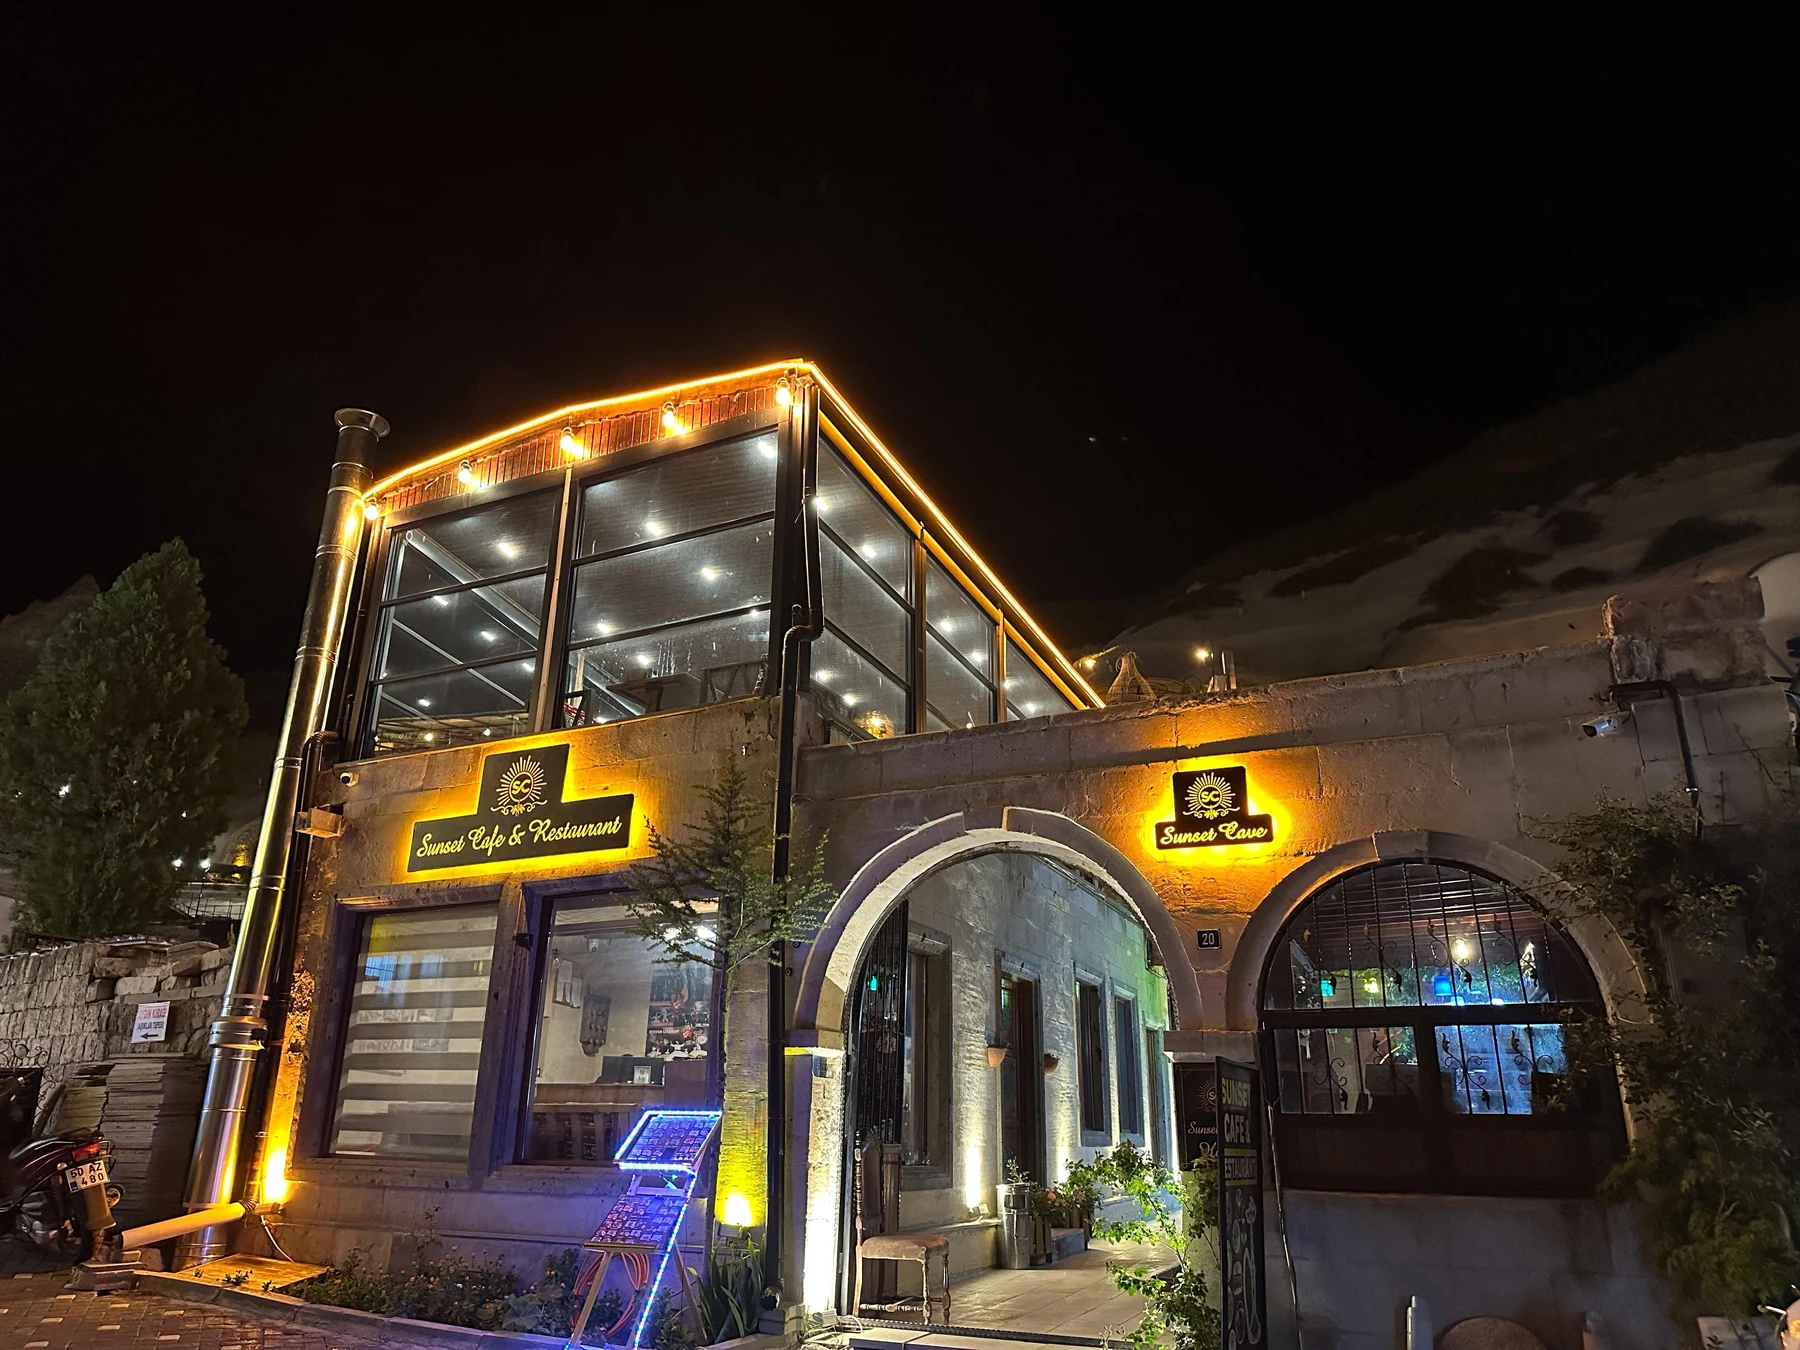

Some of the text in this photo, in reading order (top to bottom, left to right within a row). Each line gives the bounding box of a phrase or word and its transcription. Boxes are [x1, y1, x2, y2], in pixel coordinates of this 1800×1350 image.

[416, 815, 622, 858] Sunset Cafe & Restaurant
[1160, 821, 1268, 845] Sunset Cave
[1201, 933, 1215, 946] 20
[1222, 1078, 1251, 1107] SUNSET
[1224, 1113, 1245, 1143] CAFE
[71, 1163, 102, 1178] 50 AZ
[82, 1173, 103, 1185] 480
